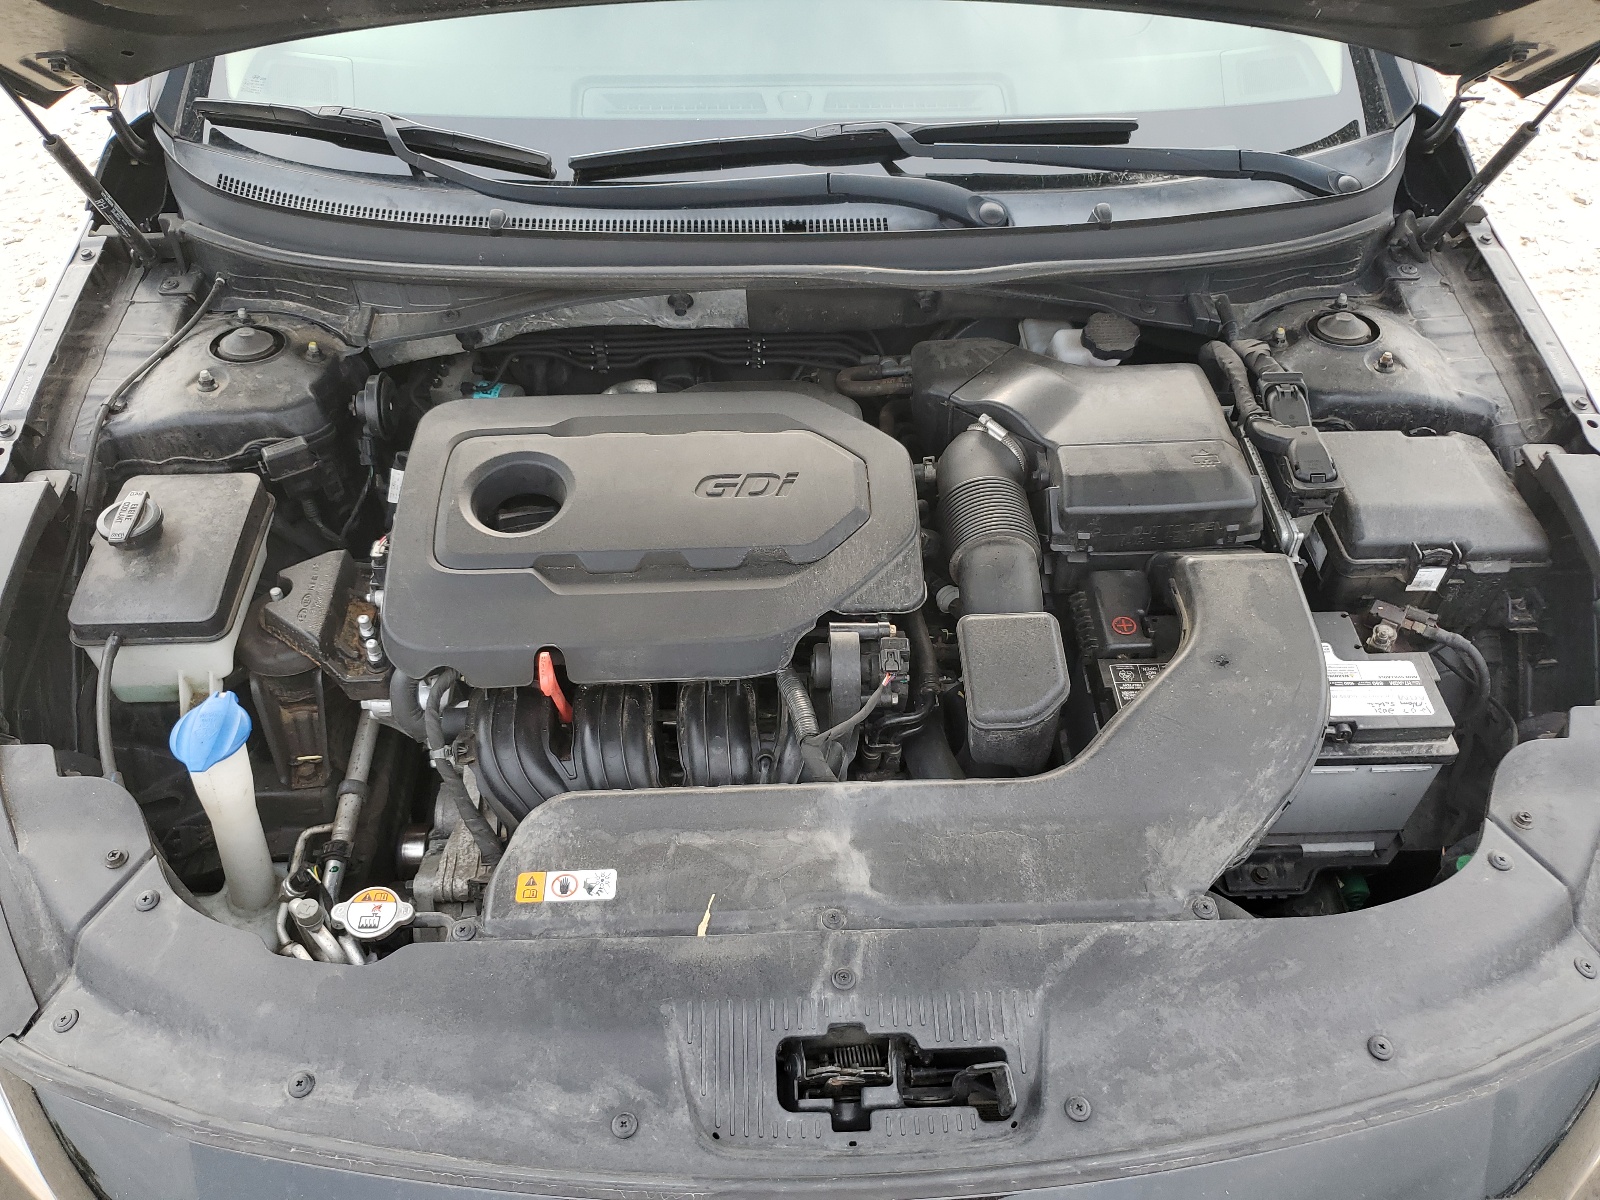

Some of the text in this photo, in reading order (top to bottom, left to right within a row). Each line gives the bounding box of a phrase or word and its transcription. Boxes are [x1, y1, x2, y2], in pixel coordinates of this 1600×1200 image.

[95, 199, 109, 210] RH
[694, 471, 800, 499] GDi
[115, 501, 131, 523] COOLANT
[124, 503, 139, 521] ENGINE
